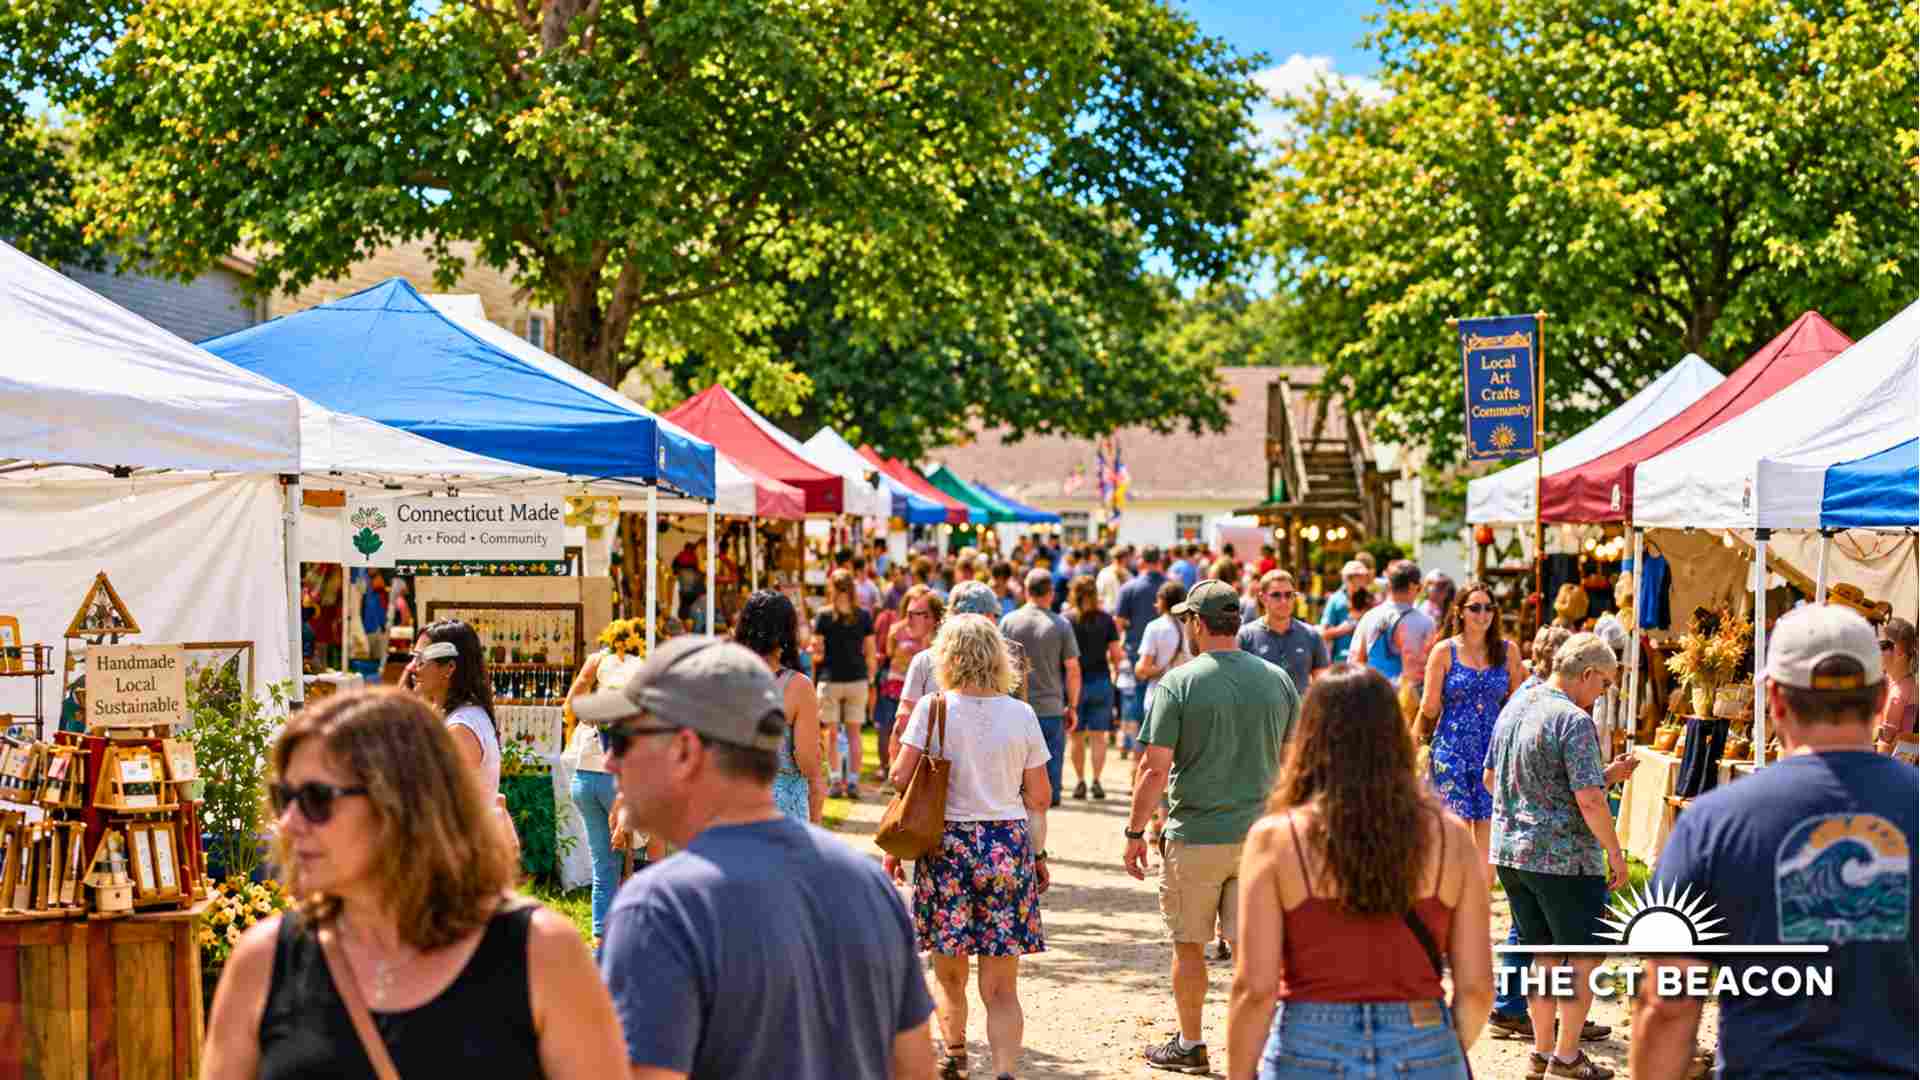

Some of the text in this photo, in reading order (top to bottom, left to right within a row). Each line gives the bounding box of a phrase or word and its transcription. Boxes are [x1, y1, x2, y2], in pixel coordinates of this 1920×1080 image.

[1481, 354, 1516, 369] Local
[1490, 371, 1512, 385] Art
[1481, 387, 1521, 401] Crafts
[1472, 403, 1531, 418] Community
[397, 503, 560, 522] Connecticut Made
[404, 532, 548, 548] Art Food Community
[96, 654, 176, 671] Handmade
[115, 676, 157, 693] Local
[95, 696, 179, 715] Sustainable
